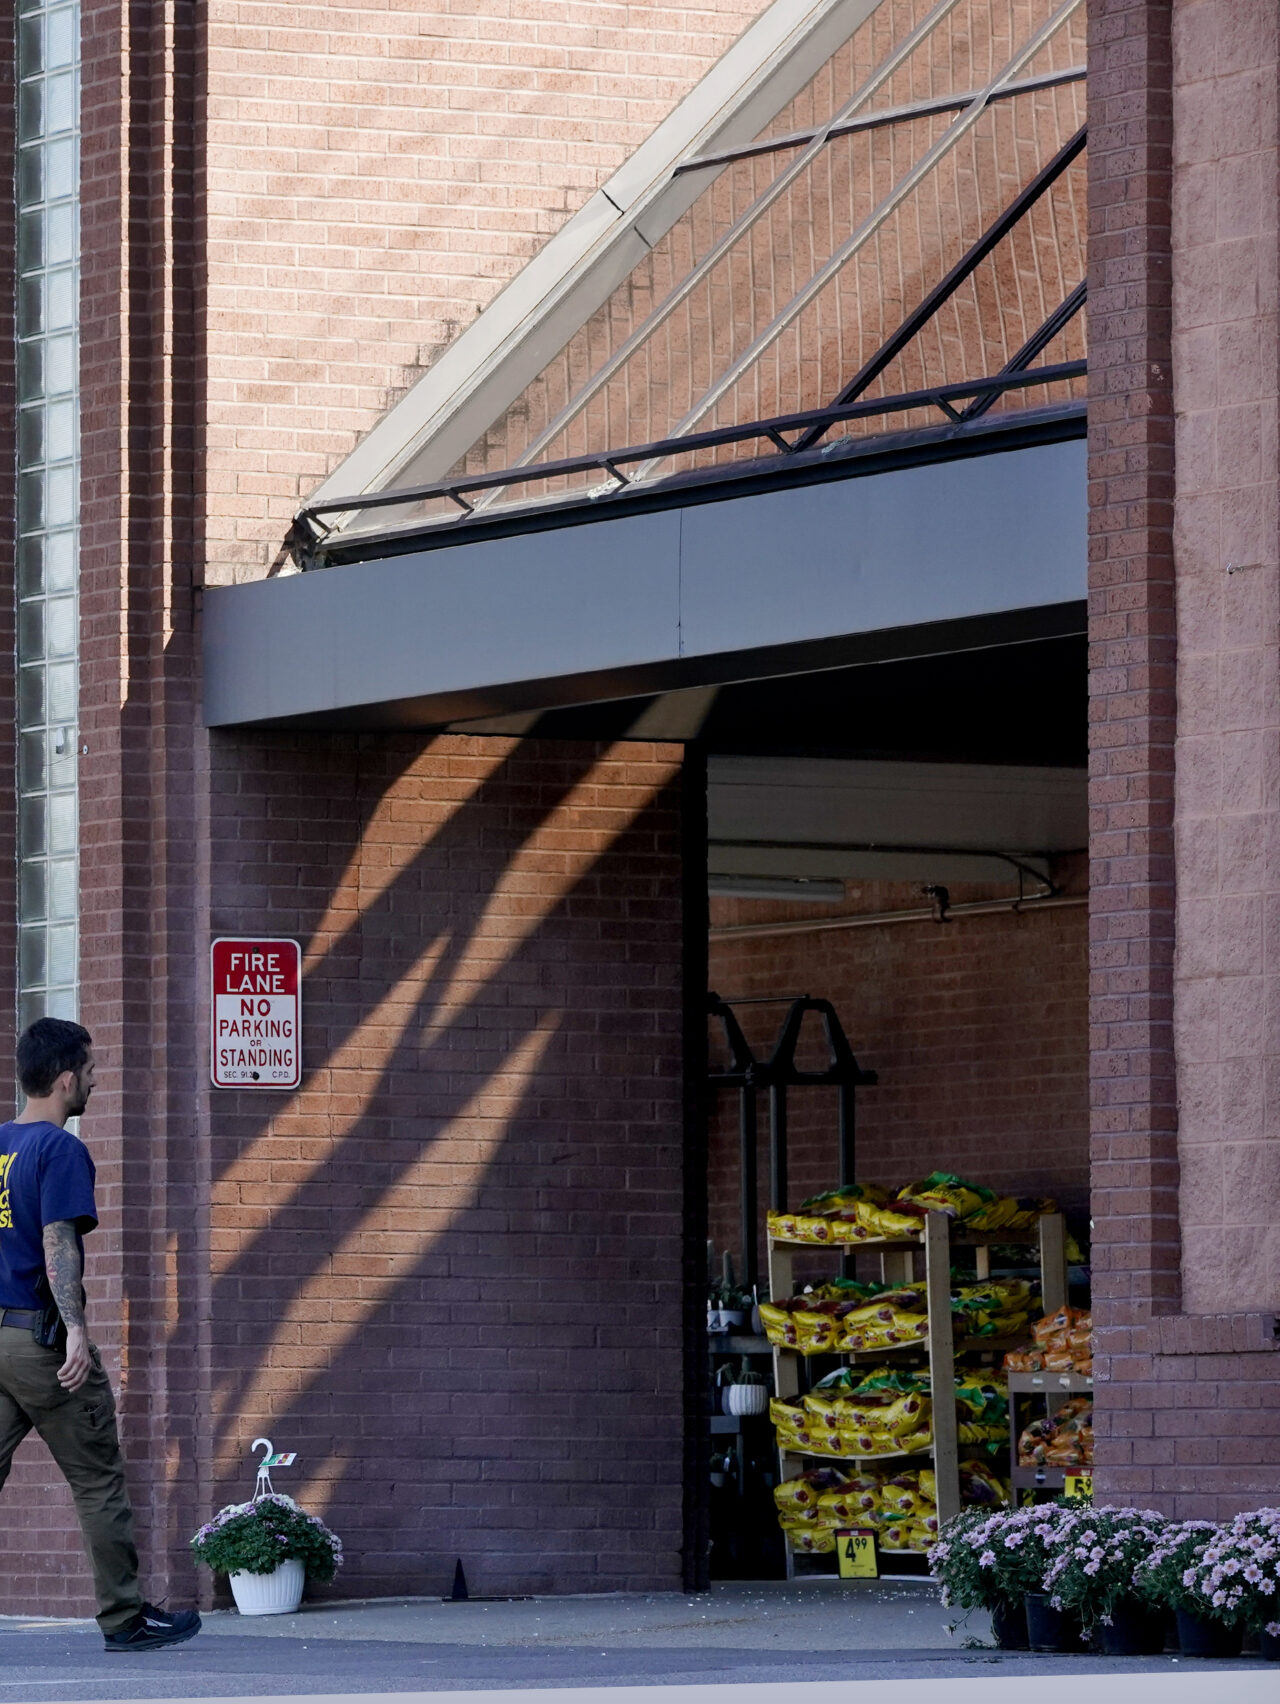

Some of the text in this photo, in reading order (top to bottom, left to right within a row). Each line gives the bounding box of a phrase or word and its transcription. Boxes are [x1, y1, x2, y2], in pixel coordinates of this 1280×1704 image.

[230, 953, 281, 972] FIRE
[226, 974, 285, 993] LANE
[240, 998, 271, 1017] NO
[219, 1019, 293, 1038] PARKING
[249, 1039, 262, 1047] OR
[219, 1048, 293, 1067] STANDING
